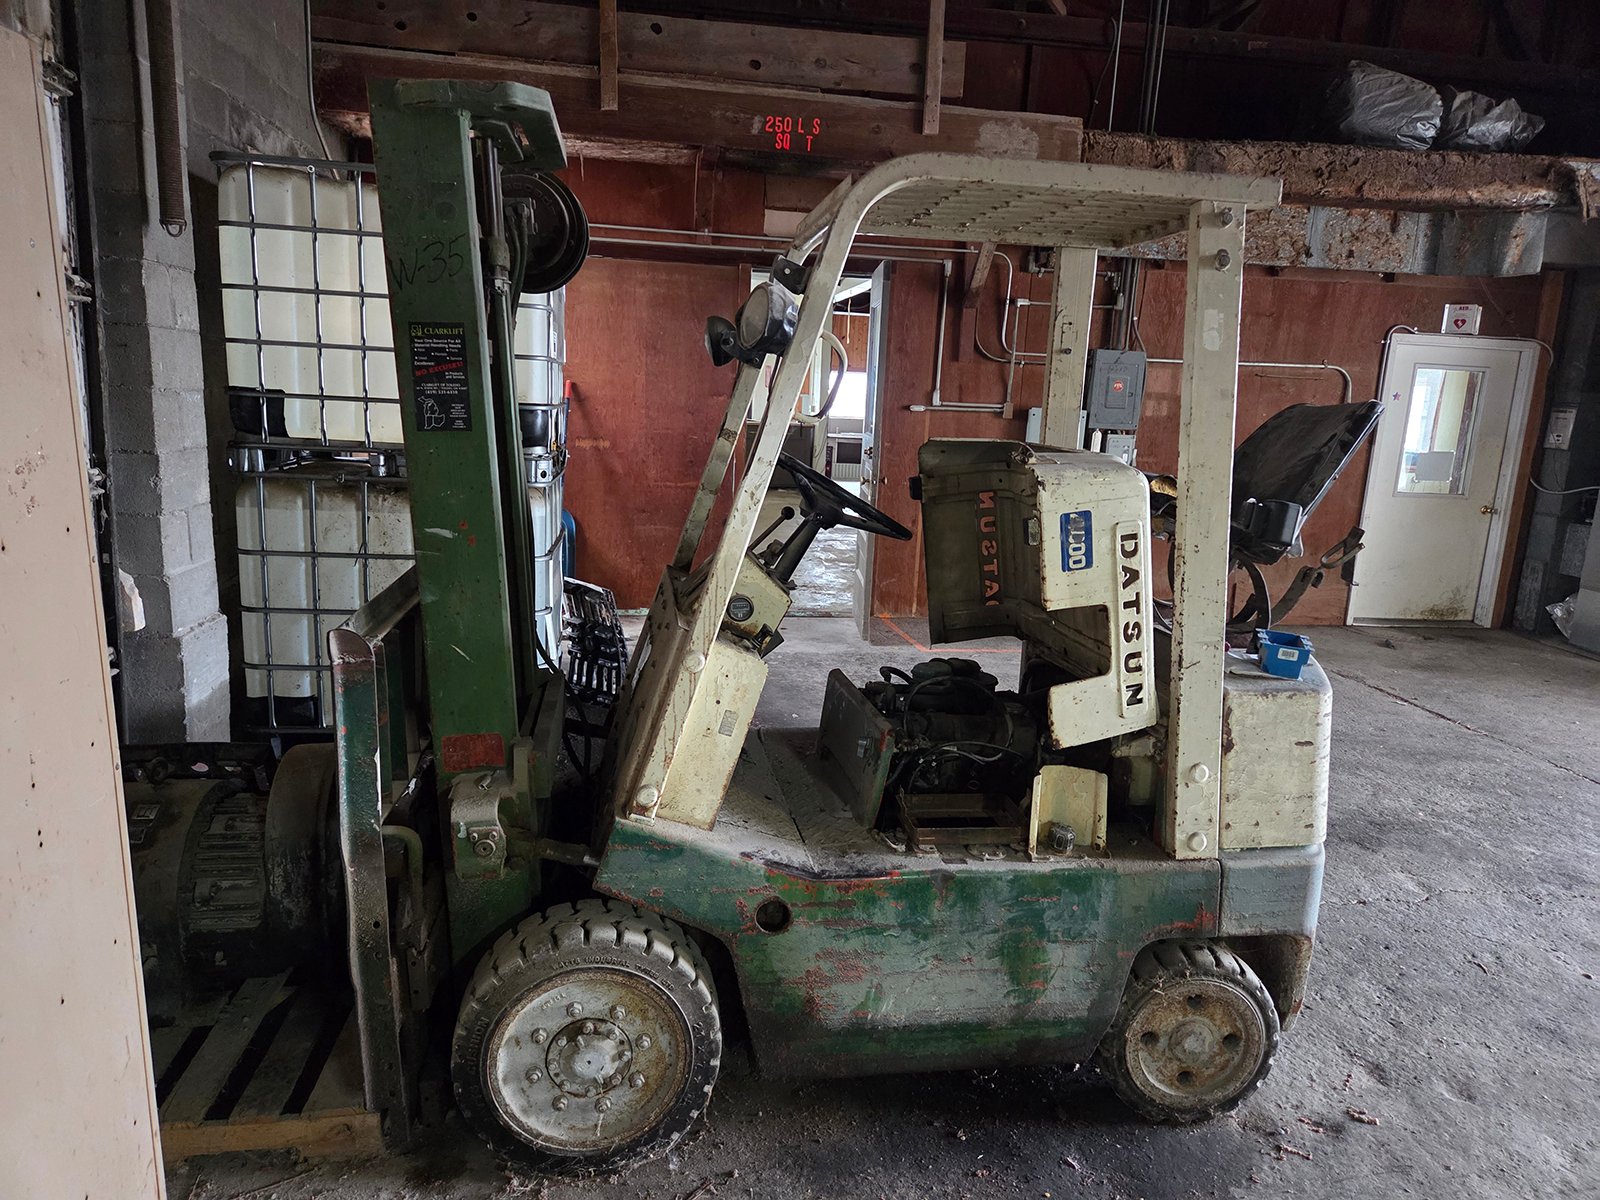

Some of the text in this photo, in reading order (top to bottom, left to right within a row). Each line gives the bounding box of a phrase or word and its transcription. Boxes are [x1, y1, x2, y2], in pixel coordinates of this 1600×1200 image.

[765, 116, 792, 132] 250
[776, 133, 790, 150] SQ
[387, 232, 466, 290] W-35
[424, 327, 464, 335] CLARKLIFT
[1120, 532, 1144, 707] DATSUN
